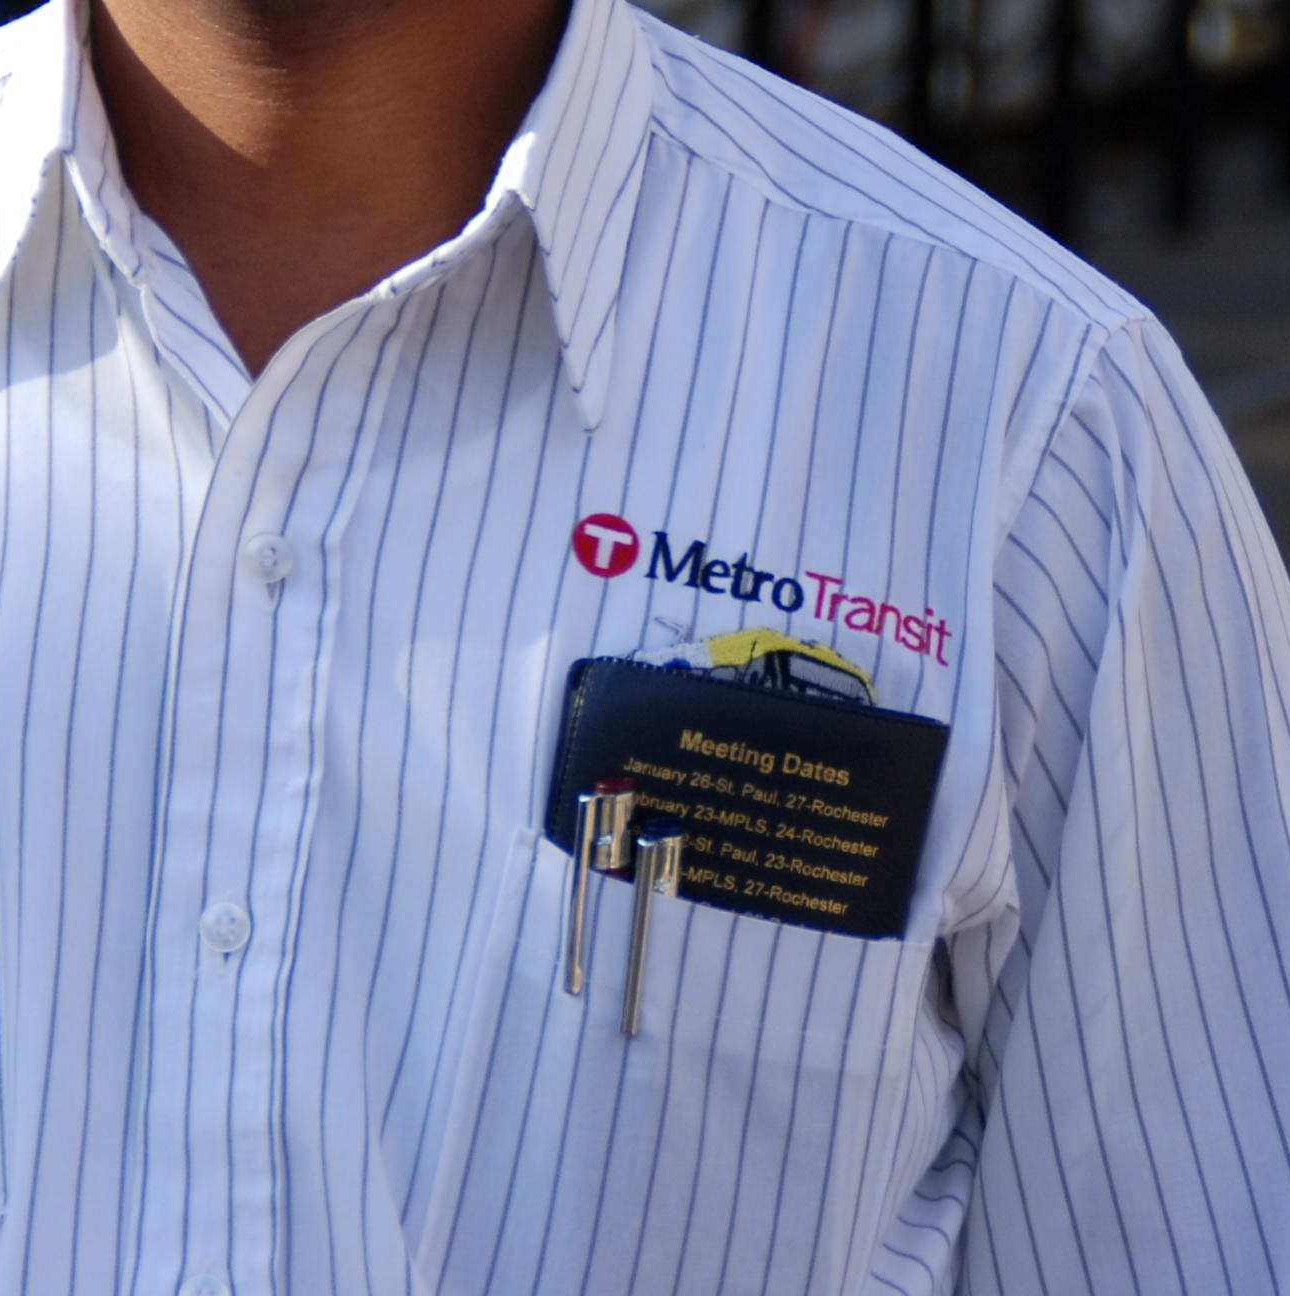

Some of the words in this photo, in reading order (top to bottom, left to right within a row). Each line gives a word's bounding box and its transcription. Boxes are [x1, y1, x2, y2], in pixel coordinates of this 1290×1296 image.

[679, 729, 776, 773] Meeting
[782, 752, 851, 787] Dates
[623, 756, 688, 786] January
[741, 783, 780, 807] Paul,
[785, 793, 890, 829] 27-Rochester
[634, 791, 689, 819] bruary
[694, 805, 770, 837] 23-MPLS,
[775, 822, 879, 858] 24-Rochester
[719, 842, 761, 867] Paul,
[763, 853, 870, 889] 23-Rochester
[745, 880, 850, 916] 27-Rochester
